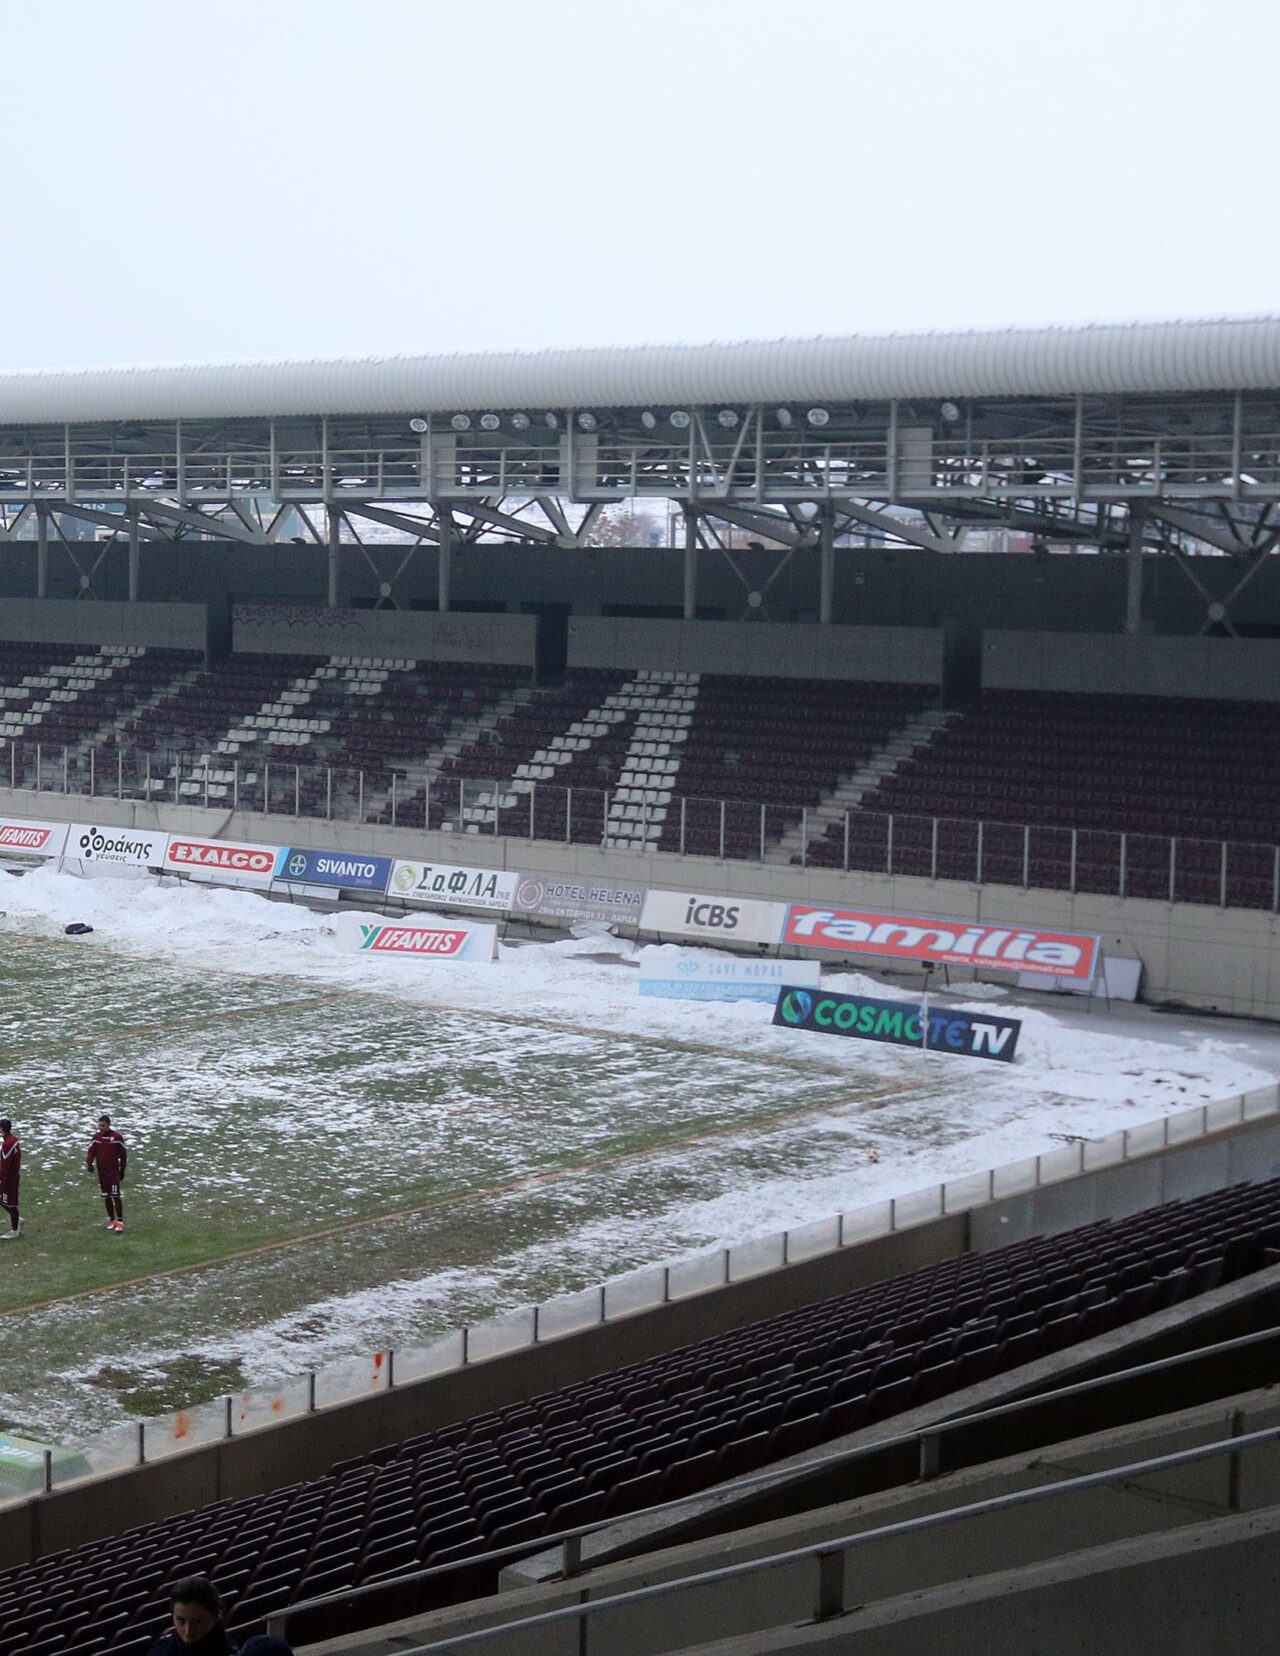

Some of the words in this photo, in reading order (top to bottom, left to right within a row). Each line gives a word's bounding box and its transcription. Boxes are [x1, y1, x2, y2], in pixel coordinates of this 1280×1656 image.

[175, 845, 269, 870] EXALCO
[316, 858, 376, 878] SIVANTO
[545, 884, 586, 900] HOTEL
[589, 888, 642, 906] HELENA
[685, 897, 740, 929] iCBS
[793, 910, 1083, 967] familia
[814, 999, 969, 1047] COSMOTE
[971, 1022, 1013, 1054] TV
